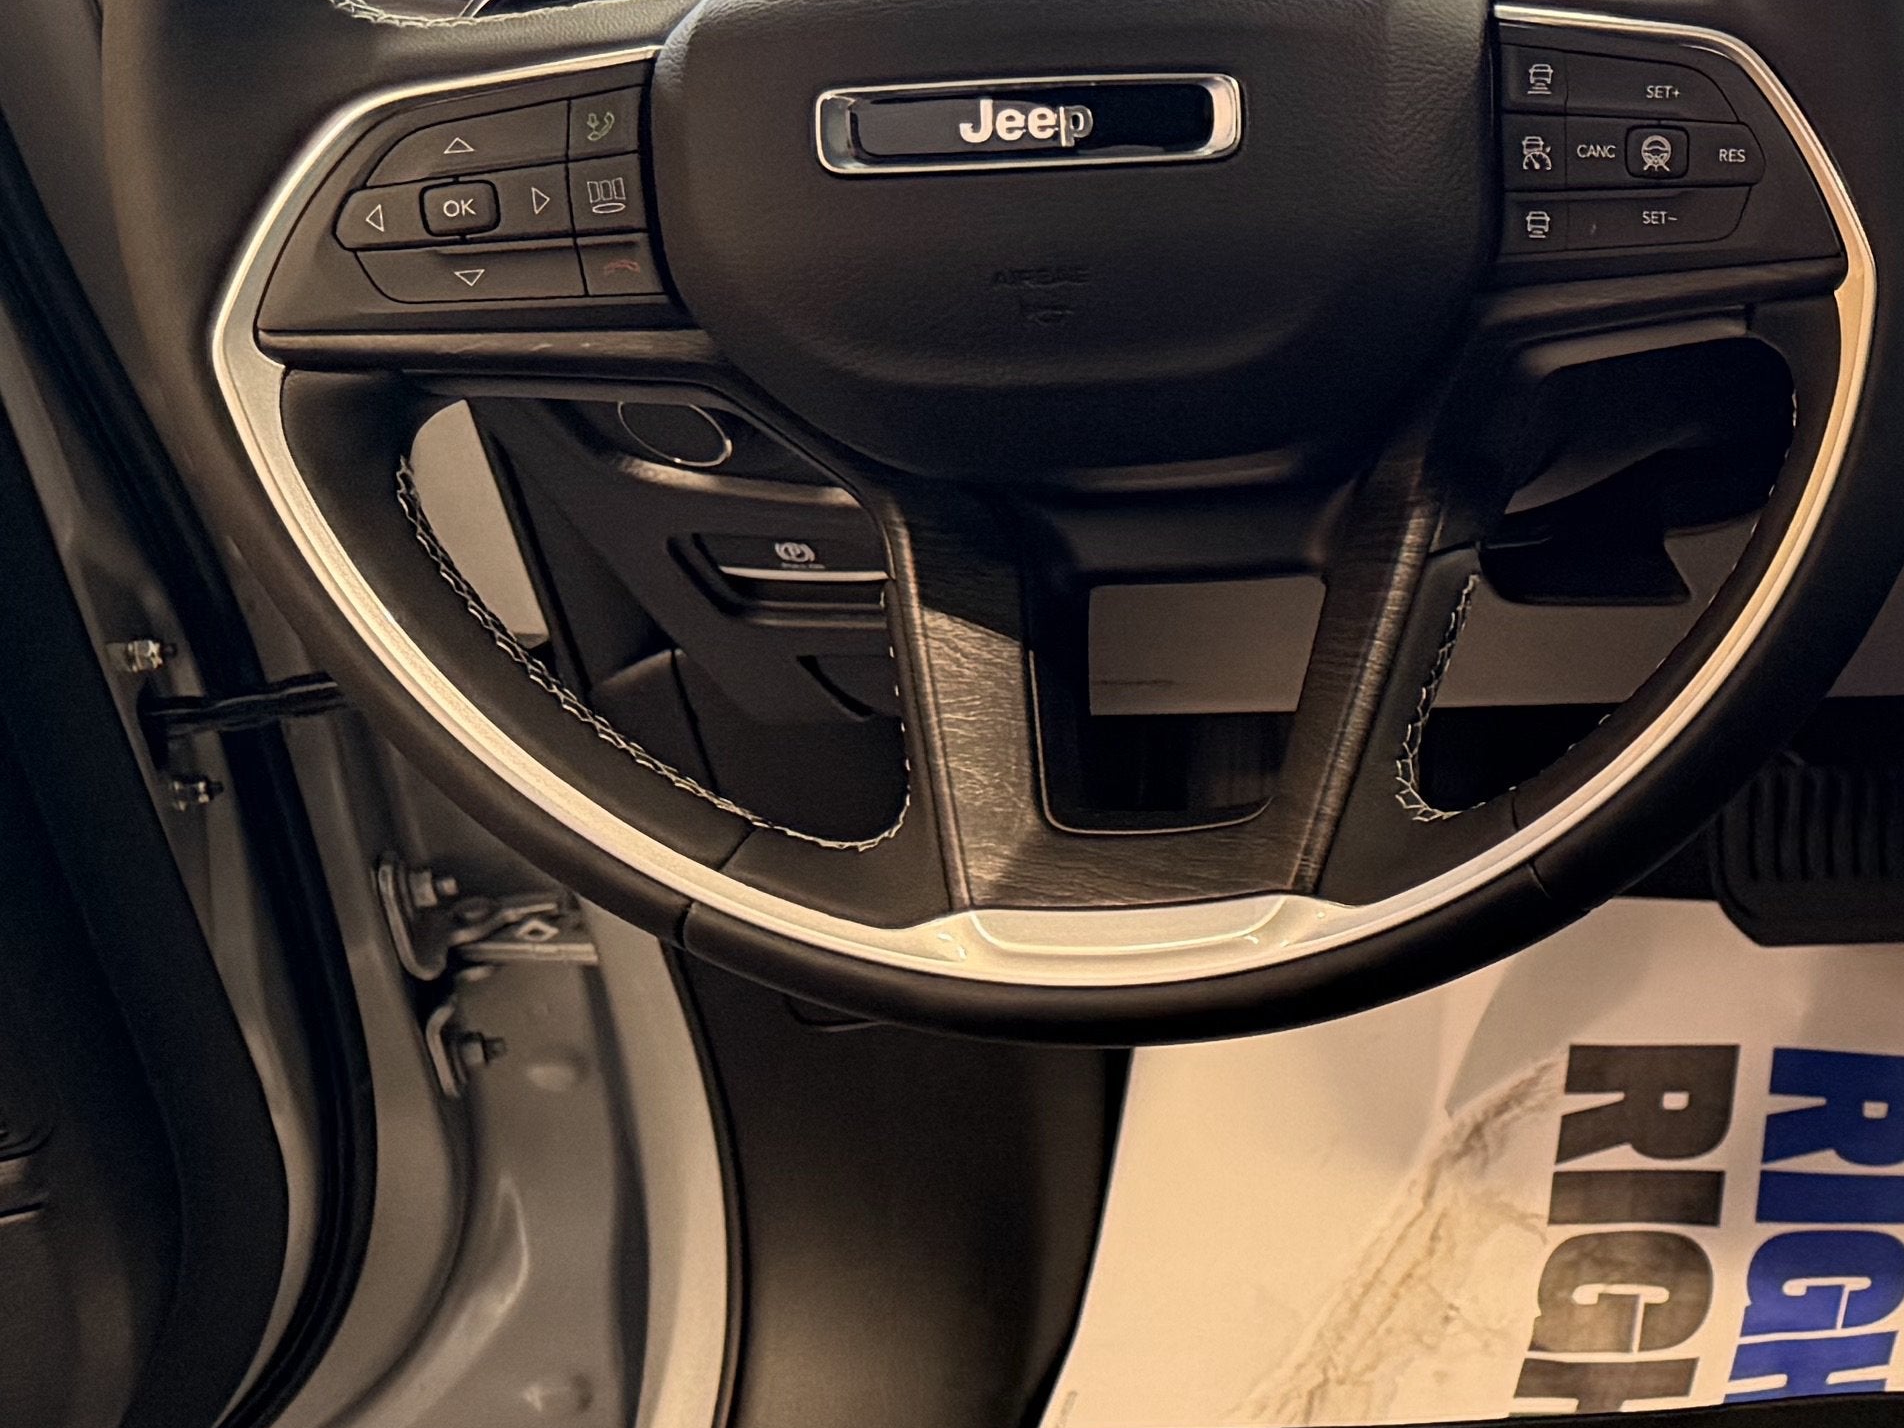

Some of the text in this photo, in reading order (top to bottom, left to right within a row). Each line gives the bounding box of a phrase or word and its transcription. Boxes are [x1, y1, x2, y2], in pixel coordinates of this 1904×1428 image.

[1646, 85, 1681, 99] SET+
[958, 99, 1094, 147] Jeep
[1576, 144, 1616, 159] CANC
[1719, 149, 1746, 163] RES
[443, 199, 476, 217] OK
